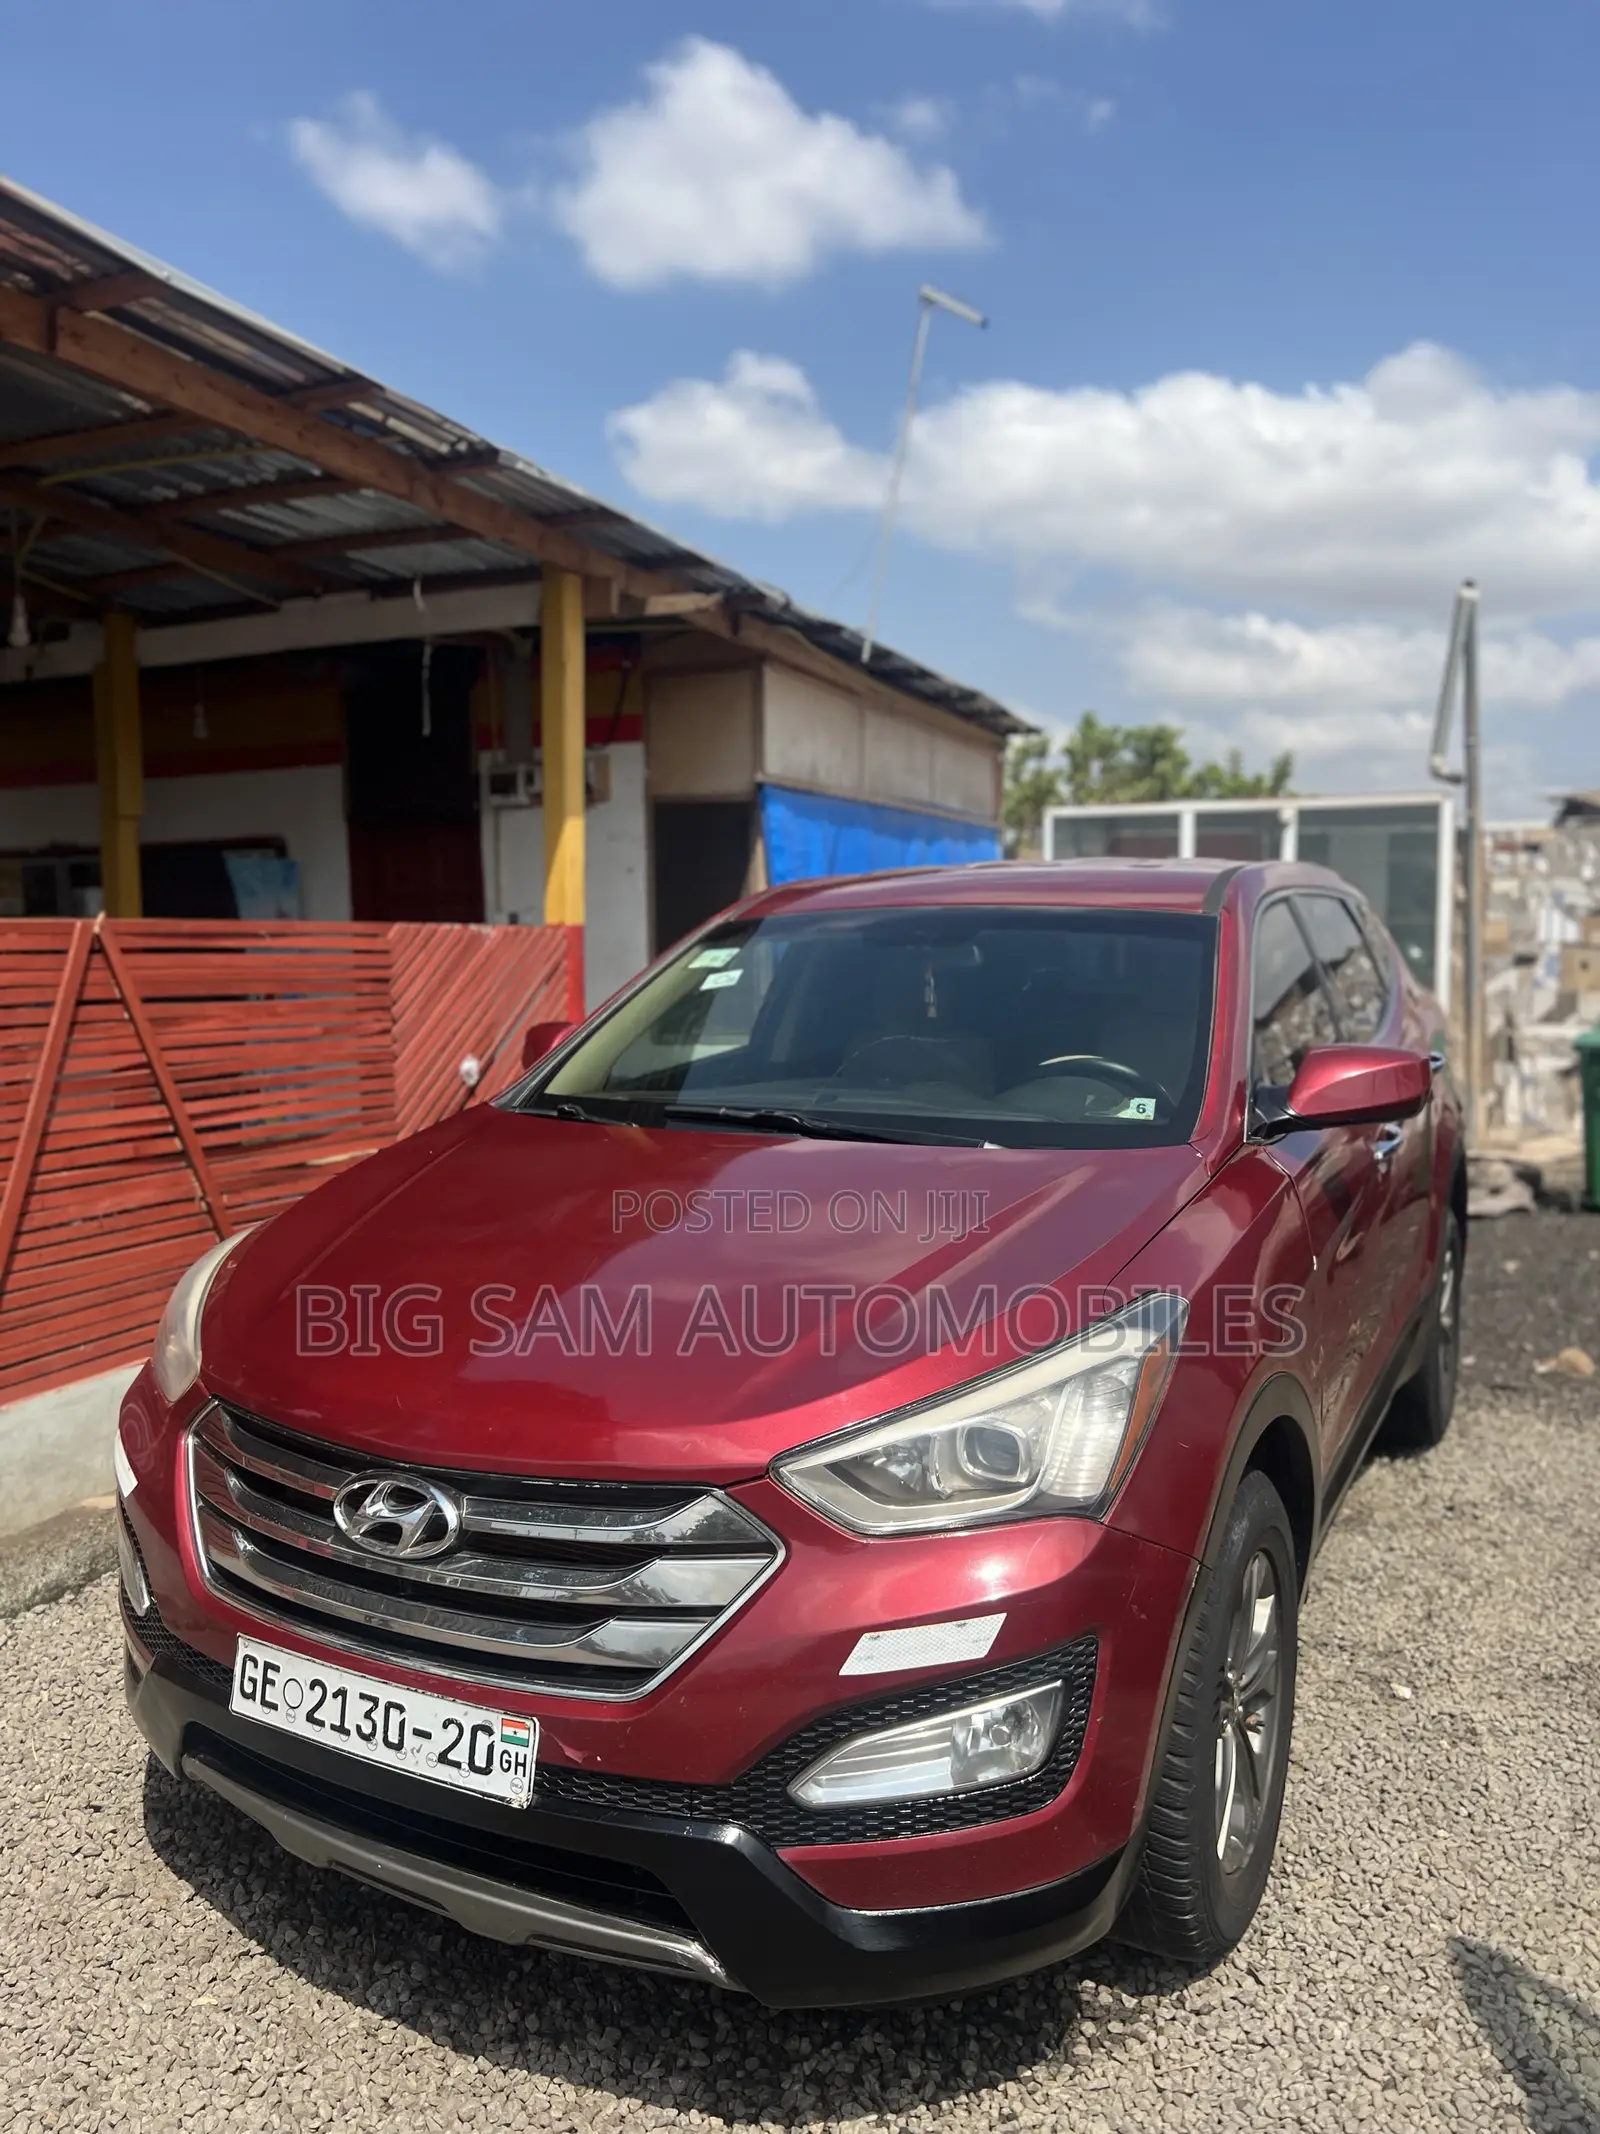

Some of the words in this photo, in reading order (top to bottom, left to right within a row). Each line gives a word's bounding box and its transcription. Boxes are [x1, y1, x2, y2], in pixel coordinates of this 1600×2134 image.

[1136, 1103, 1147, 1114] 6
[239, 1654, 280, 1711] GE
[306, 1678, 496, 1775] 2130-20
[500, 1749, 527, 1778] GH
